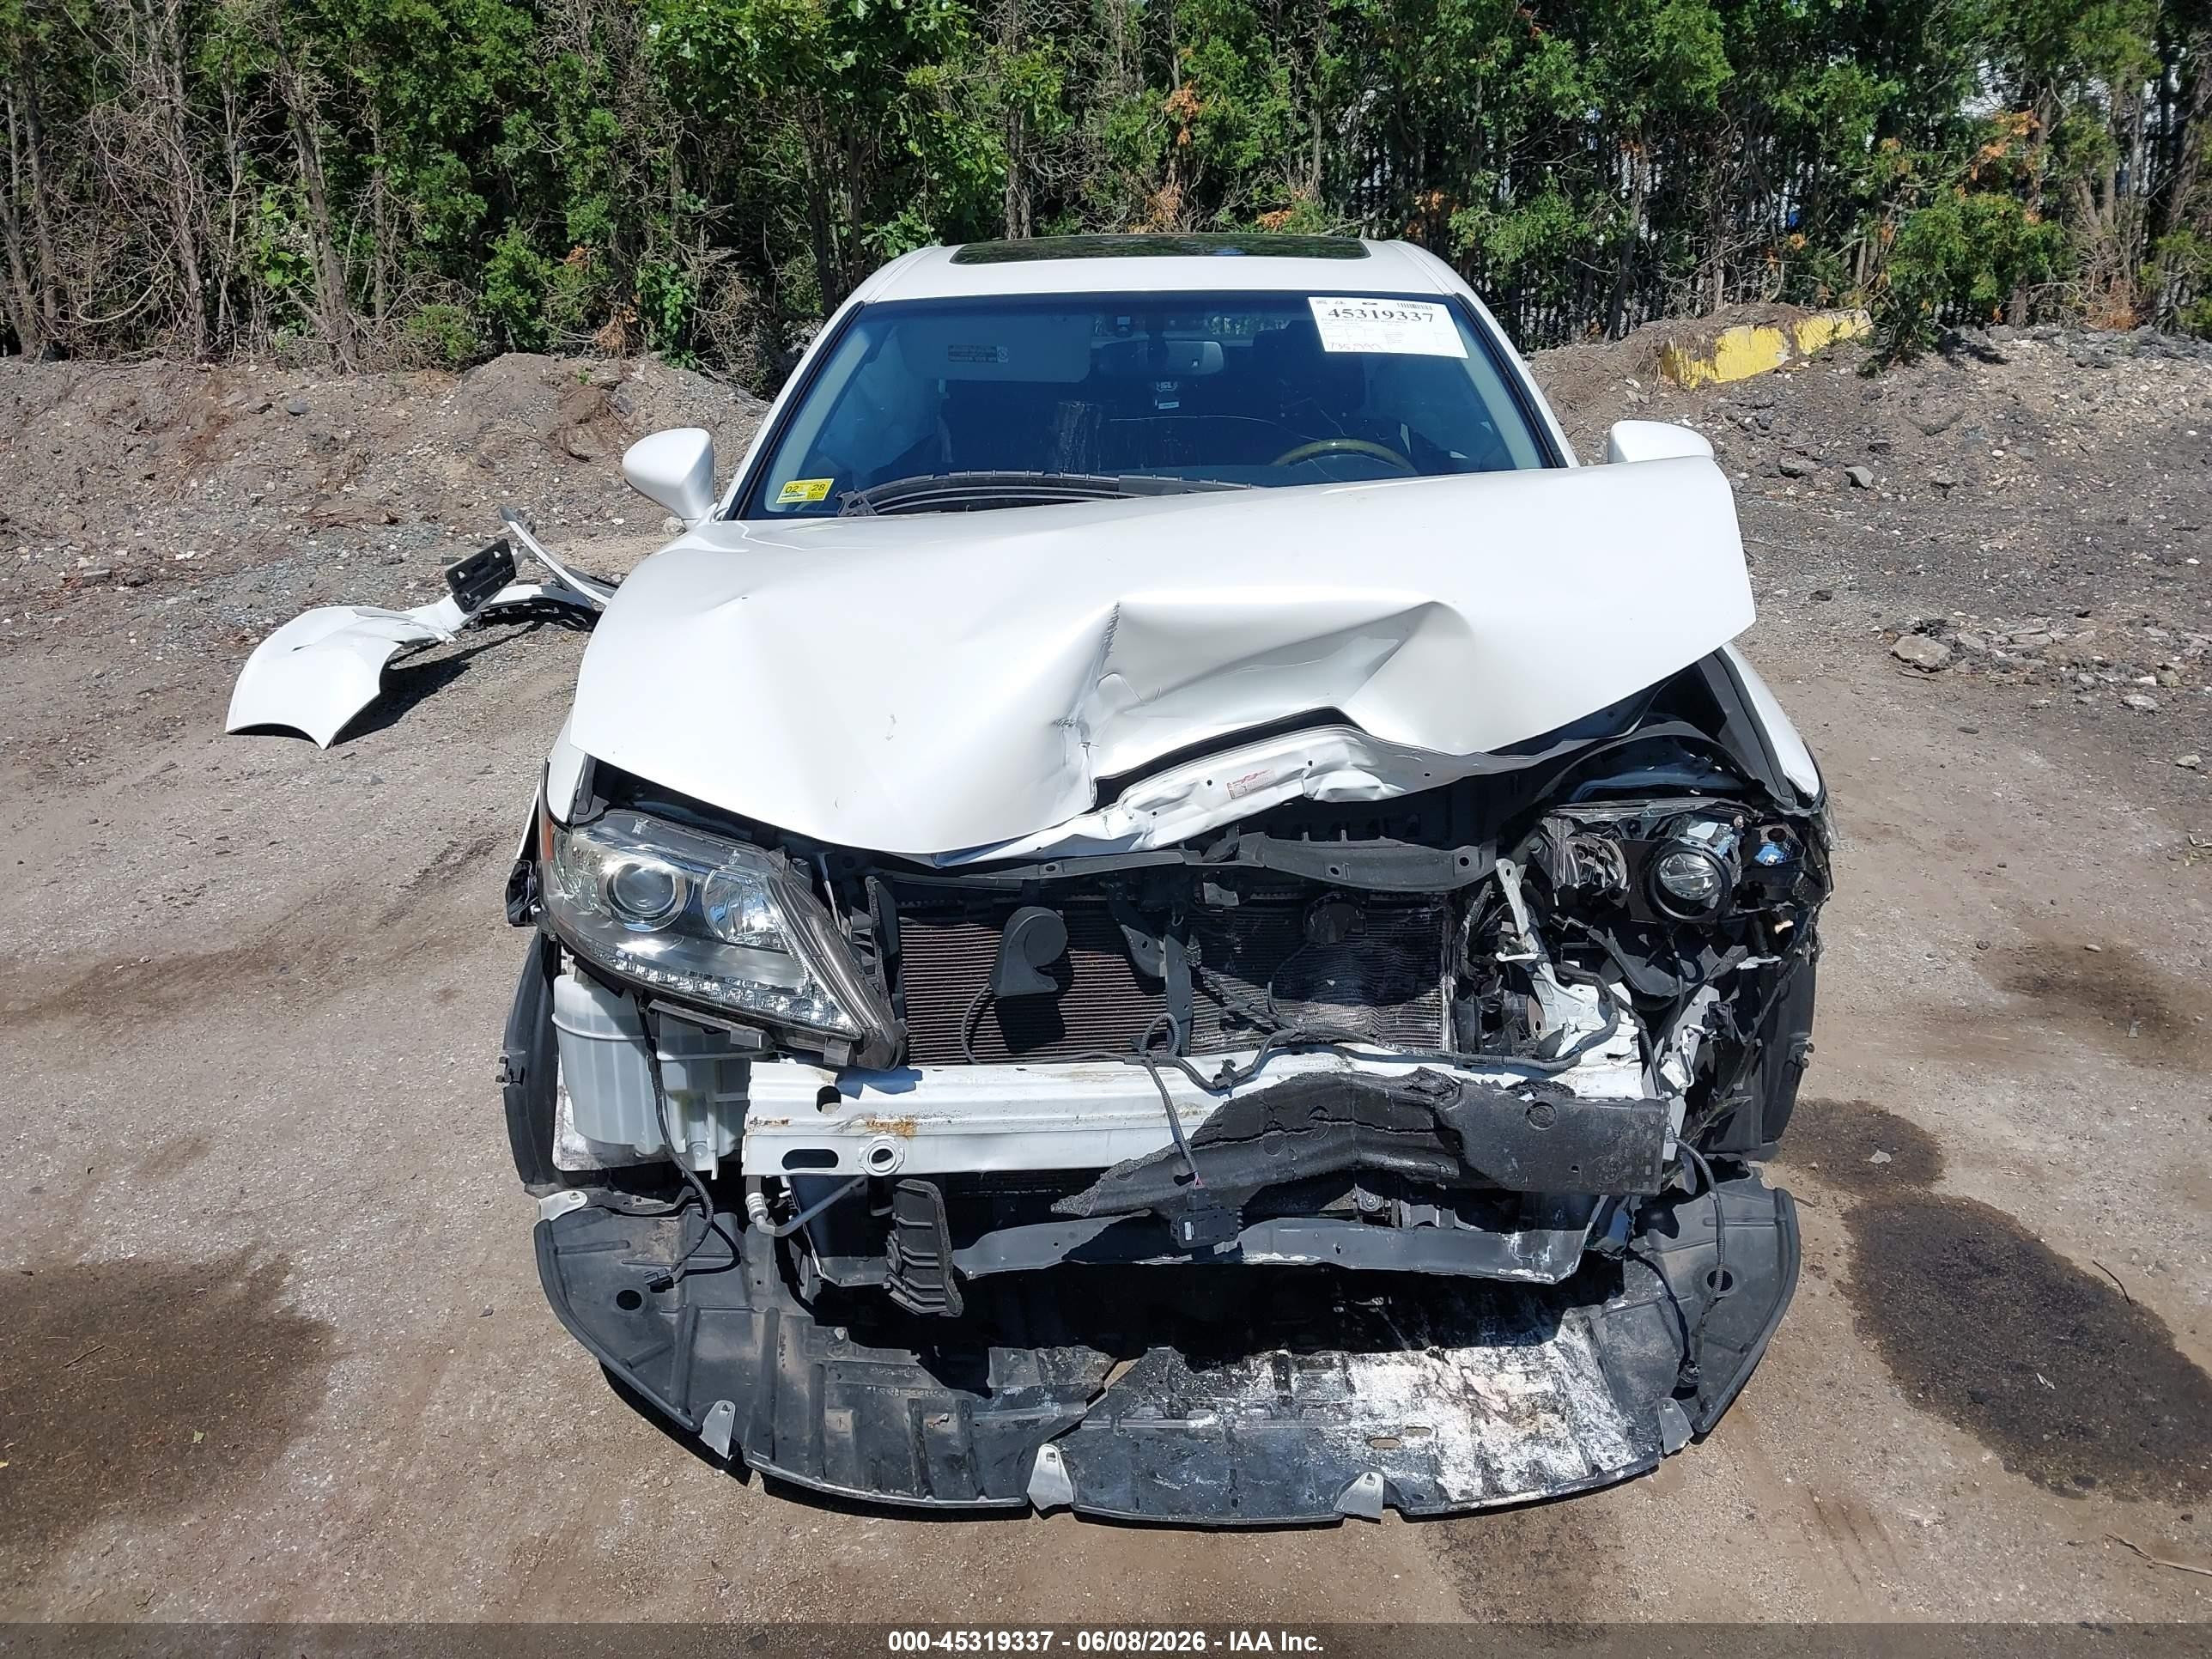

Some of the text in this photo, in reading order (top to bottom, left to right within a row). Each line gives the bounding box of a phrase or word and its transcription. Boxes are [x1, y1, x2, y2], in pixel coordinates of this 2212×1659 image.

[1328, 308, 1434, 323] 45319337
[785, 483, 825, 494] 02 28
